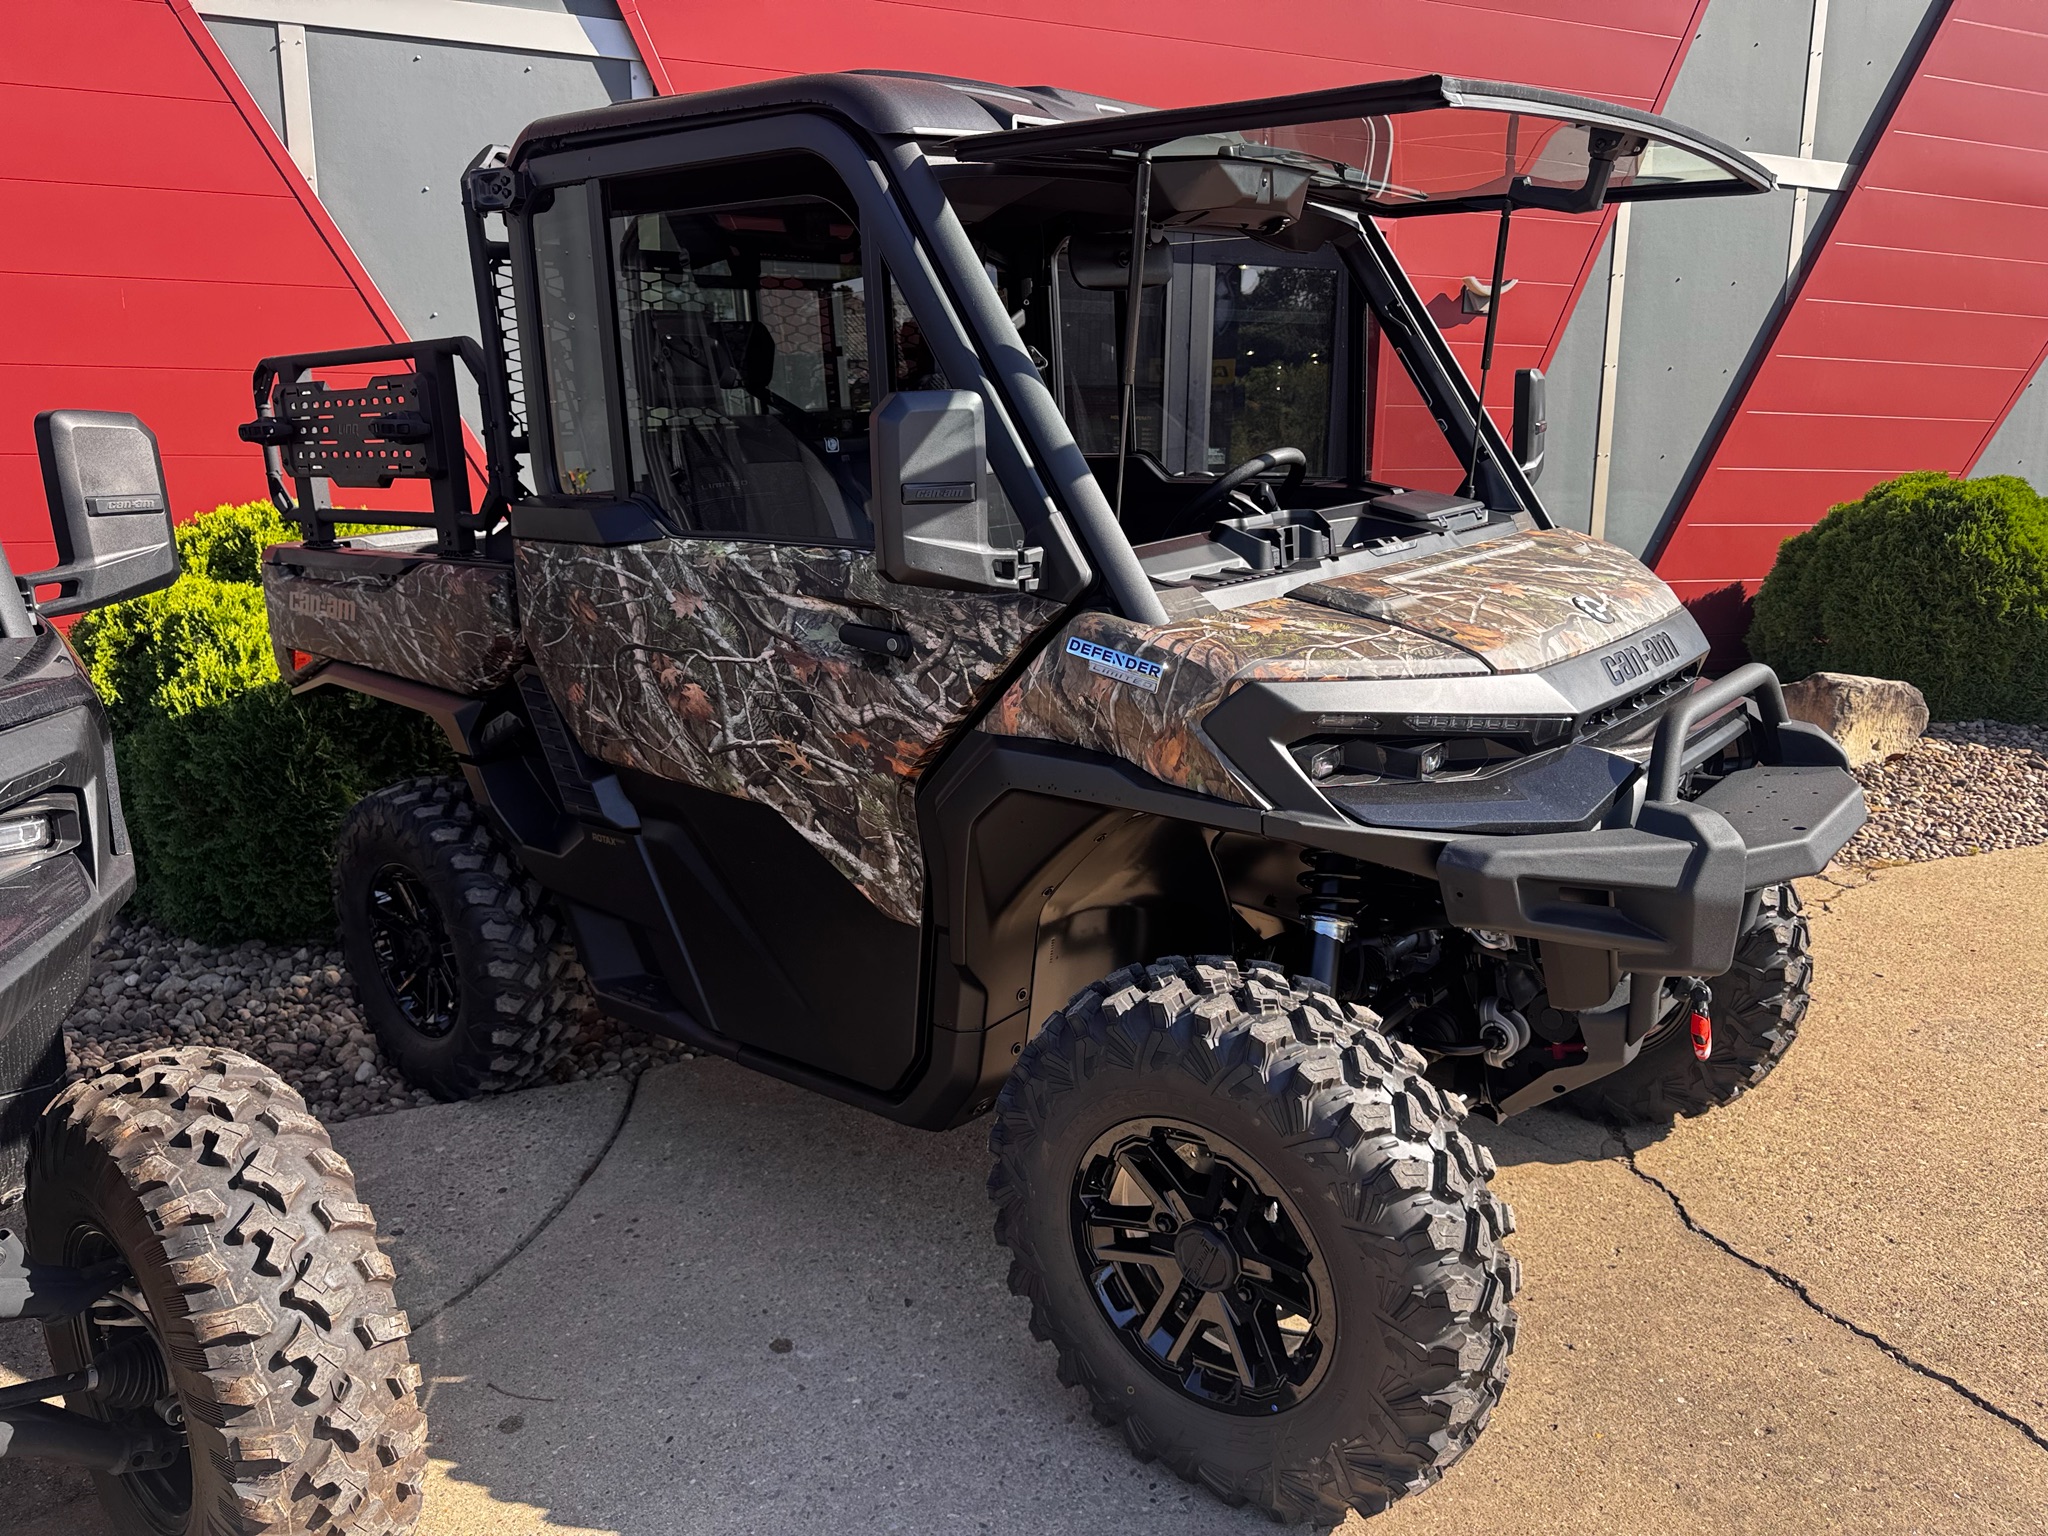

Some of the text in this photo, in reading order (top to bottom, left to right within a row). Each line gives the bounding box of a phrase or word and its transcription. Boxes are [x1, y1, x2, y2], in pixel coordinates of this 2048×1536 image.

[107, 500, 155, 510] can-am
[916, 489, 964, 498] can-am
[289, 591, 357, 622] can-am
[1068, 639, 1162, 678] DEFENDER
[1600, 631, 1680, 687] can-am
[1092, 665, 1153, 689] LIMITED
[591, 832, 617, 847] ROTAX
